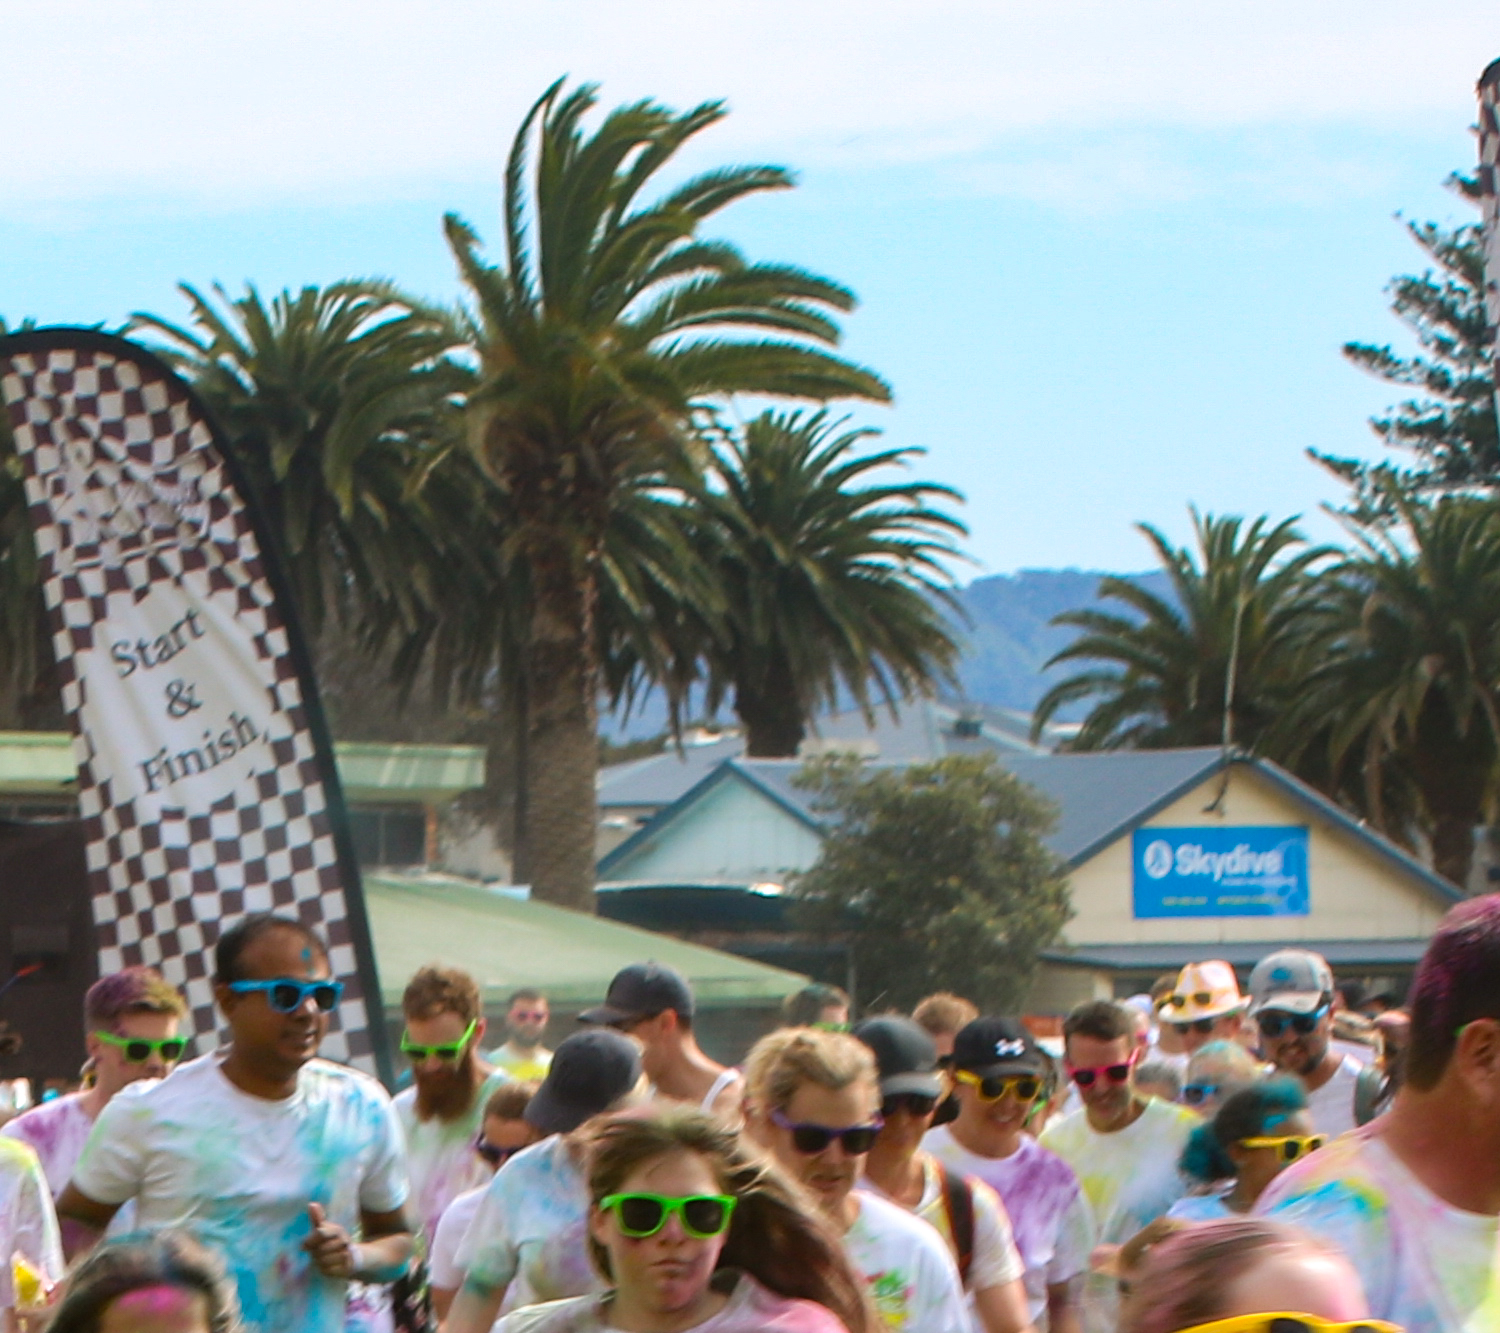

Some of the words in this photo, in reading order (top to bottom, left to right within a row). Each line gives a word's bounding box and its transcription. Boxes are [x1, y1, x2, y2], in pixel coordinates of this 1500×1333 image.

[110, 607, 206, 680] Start
[164, 677, 204, 720] &
[137, 710, 261, 794] Finish
[1174, 842, 1285, 882] Skydive
